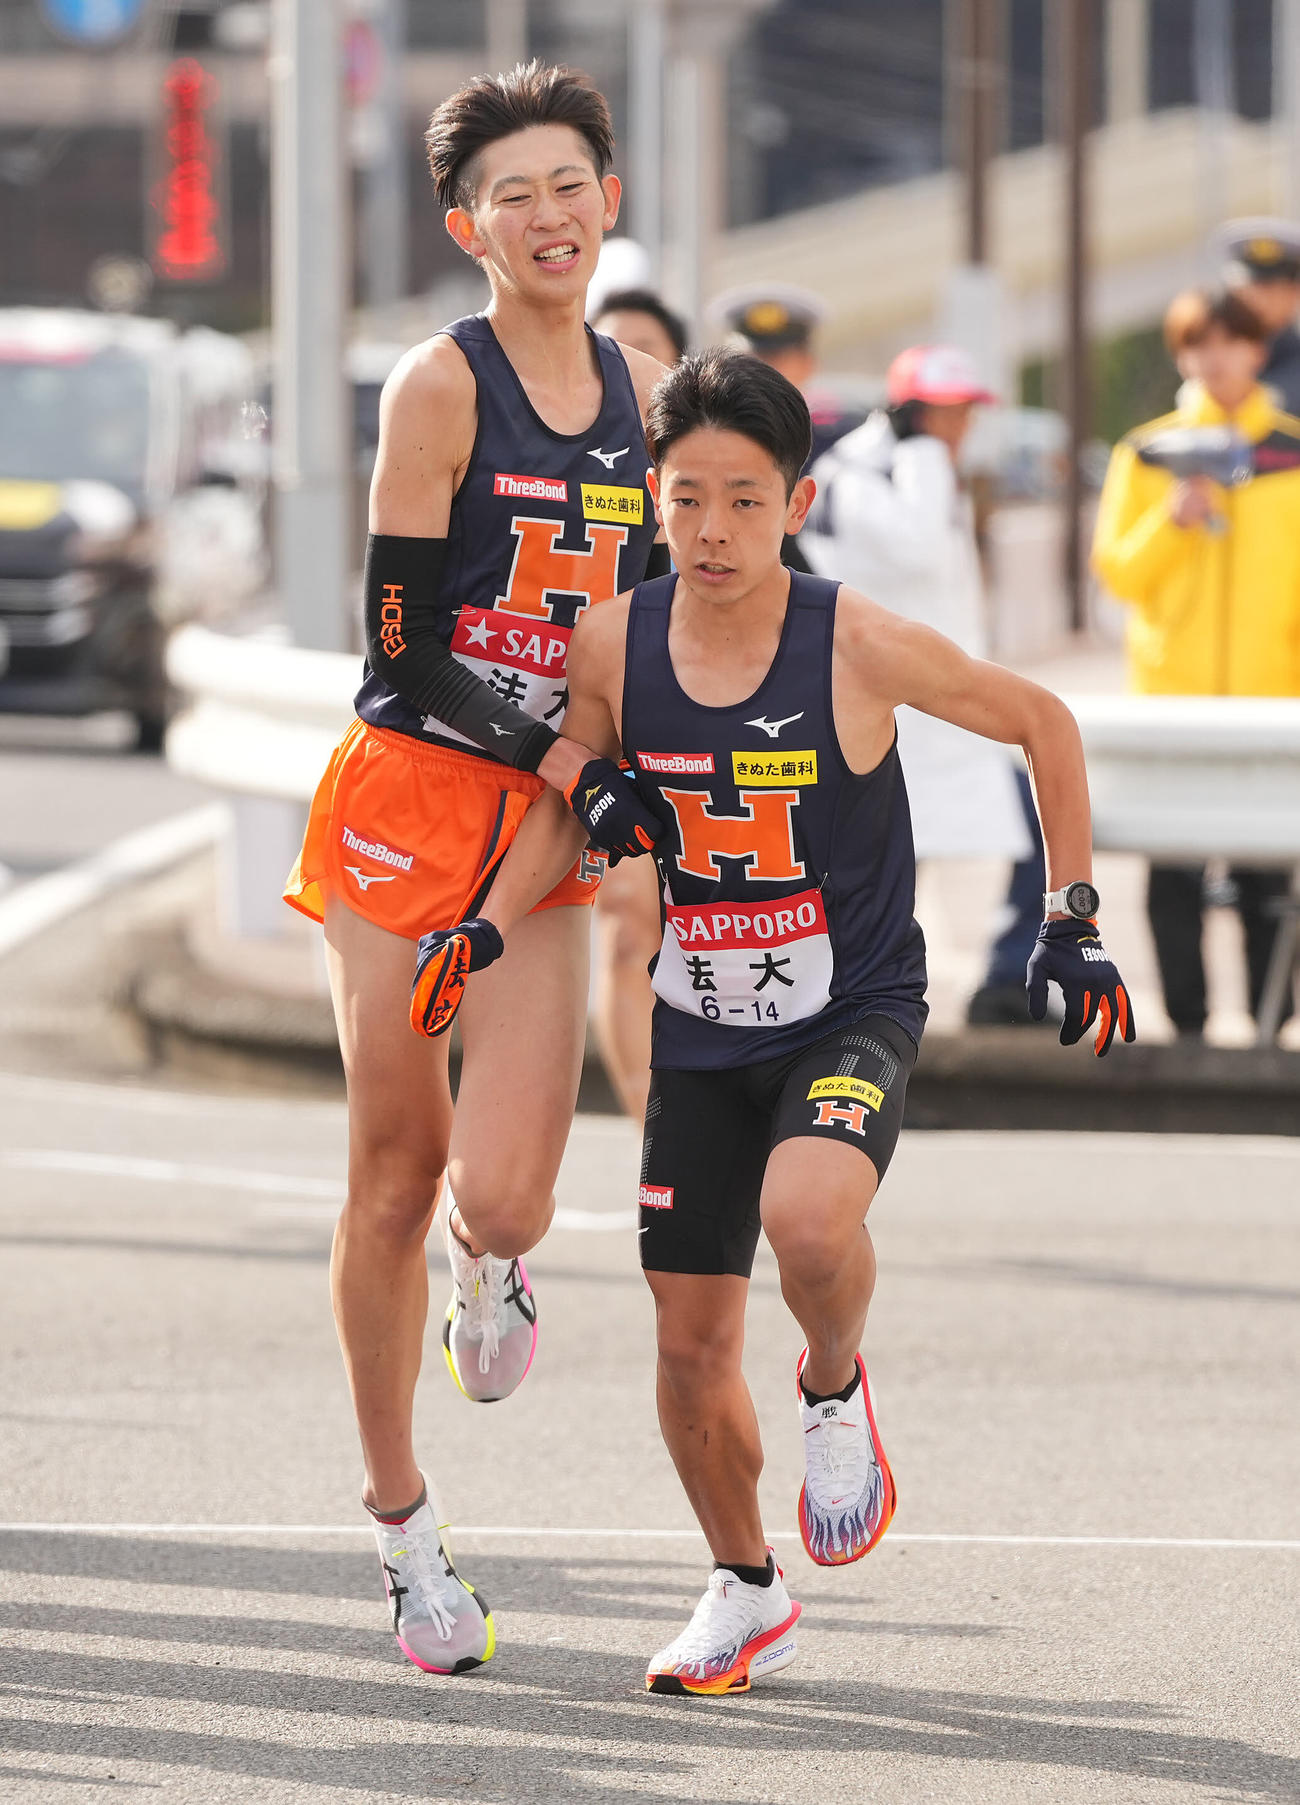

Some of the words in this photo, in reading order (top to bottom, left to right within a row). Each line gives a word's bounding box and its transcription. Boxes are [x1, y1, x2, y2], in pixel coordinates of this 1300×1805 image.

[497, 477, 567, 501] ThreeBond
[584, 494, 641, 515] きぬた歯科
[493, 515, 629, 624] H
[381, 584, 407, 660] HOSEI
[501, 628, 567, 669] SAP
[638, 754, 713, 773] ThreeBond
[736, 759, 814, 777] きぬた歯科
[589, 791, 616, 826] HOSEI
[342, 826, 414, 871] ThreeBond
[658, 786, 806, 882] H
[671, 902, 818, 942] SAPPORO
[812, 1082, 880, 1103] きぬた歯科
[812, 1101, 870, 1137] H
